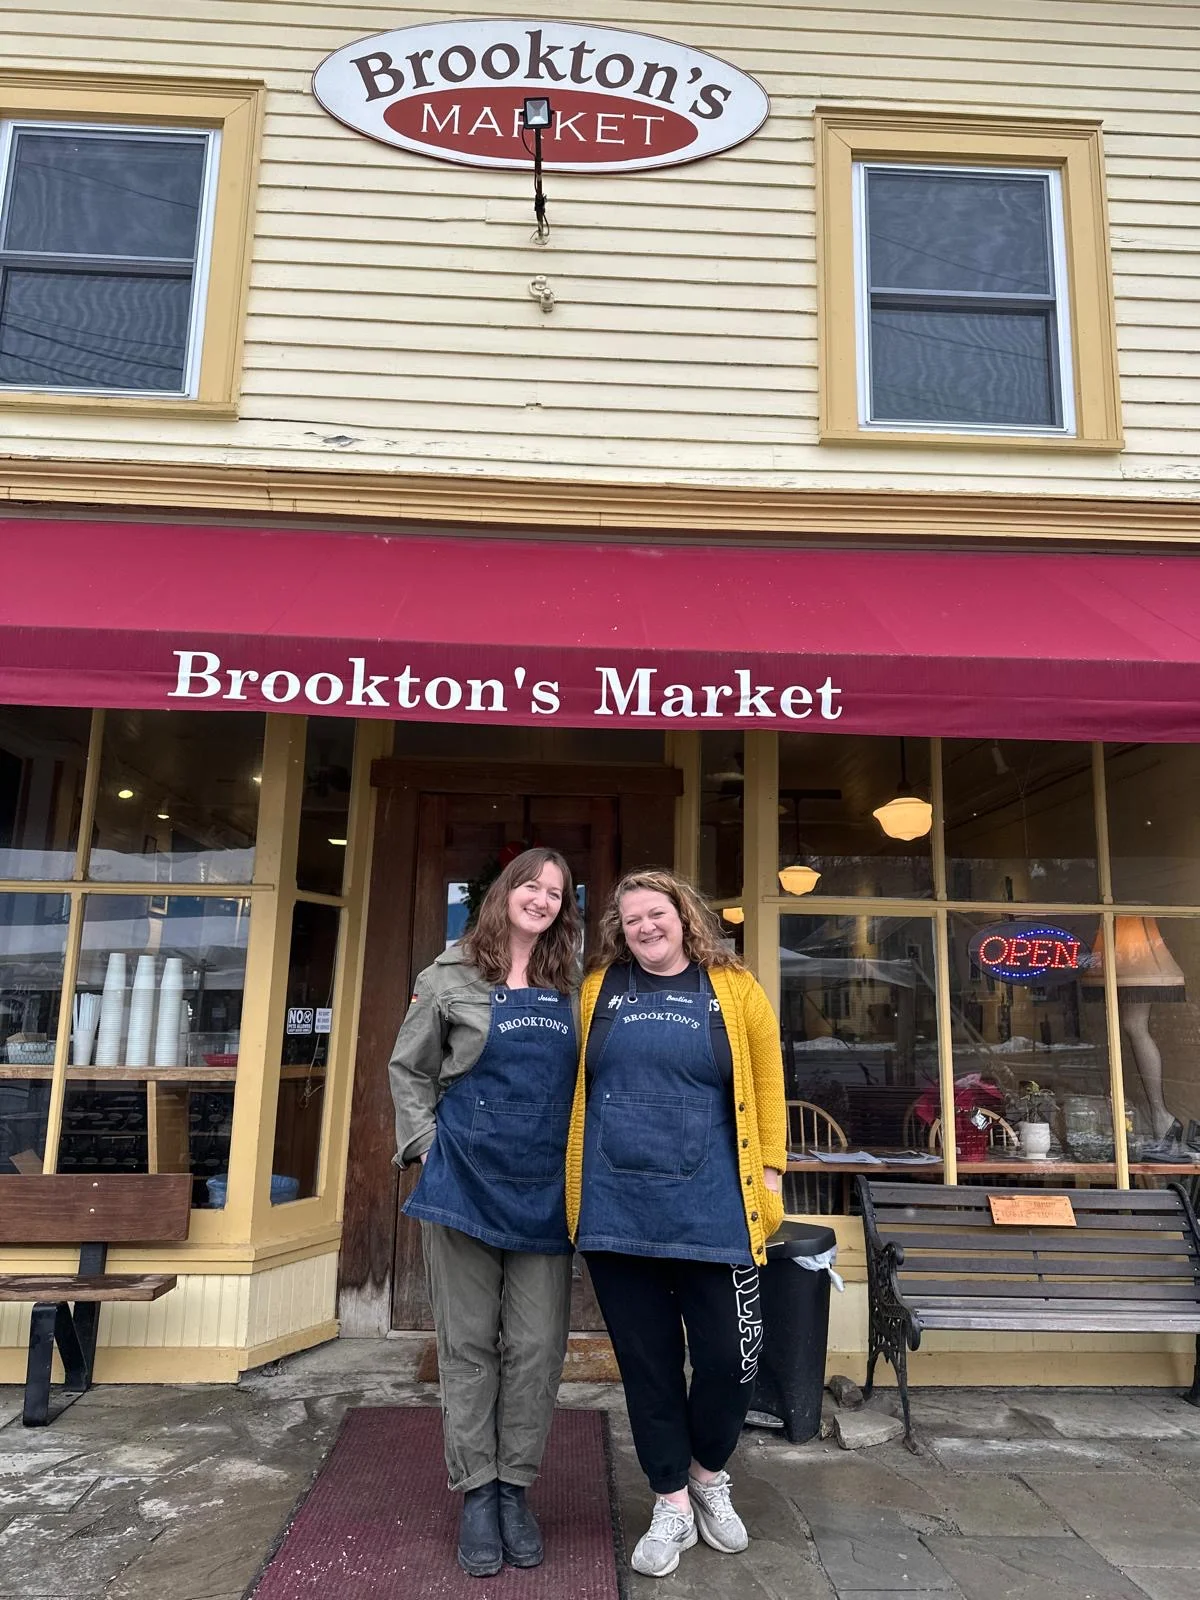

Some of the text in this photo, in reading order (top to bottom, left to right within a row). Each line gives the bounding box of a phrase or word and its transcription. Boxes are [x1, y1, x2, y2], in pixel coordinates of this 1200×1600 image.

[350, 30, 732, 120] Brookton's
[167, 649, 843, 720] Brookton's Market
[979, 935, 1080, 969] OPEN
[289, 1010, 304, 1024] NO
[497, 1016, 569, 1035] BROOKTON'S
[622, 1012, 701, 1029] BROOKTON'S
